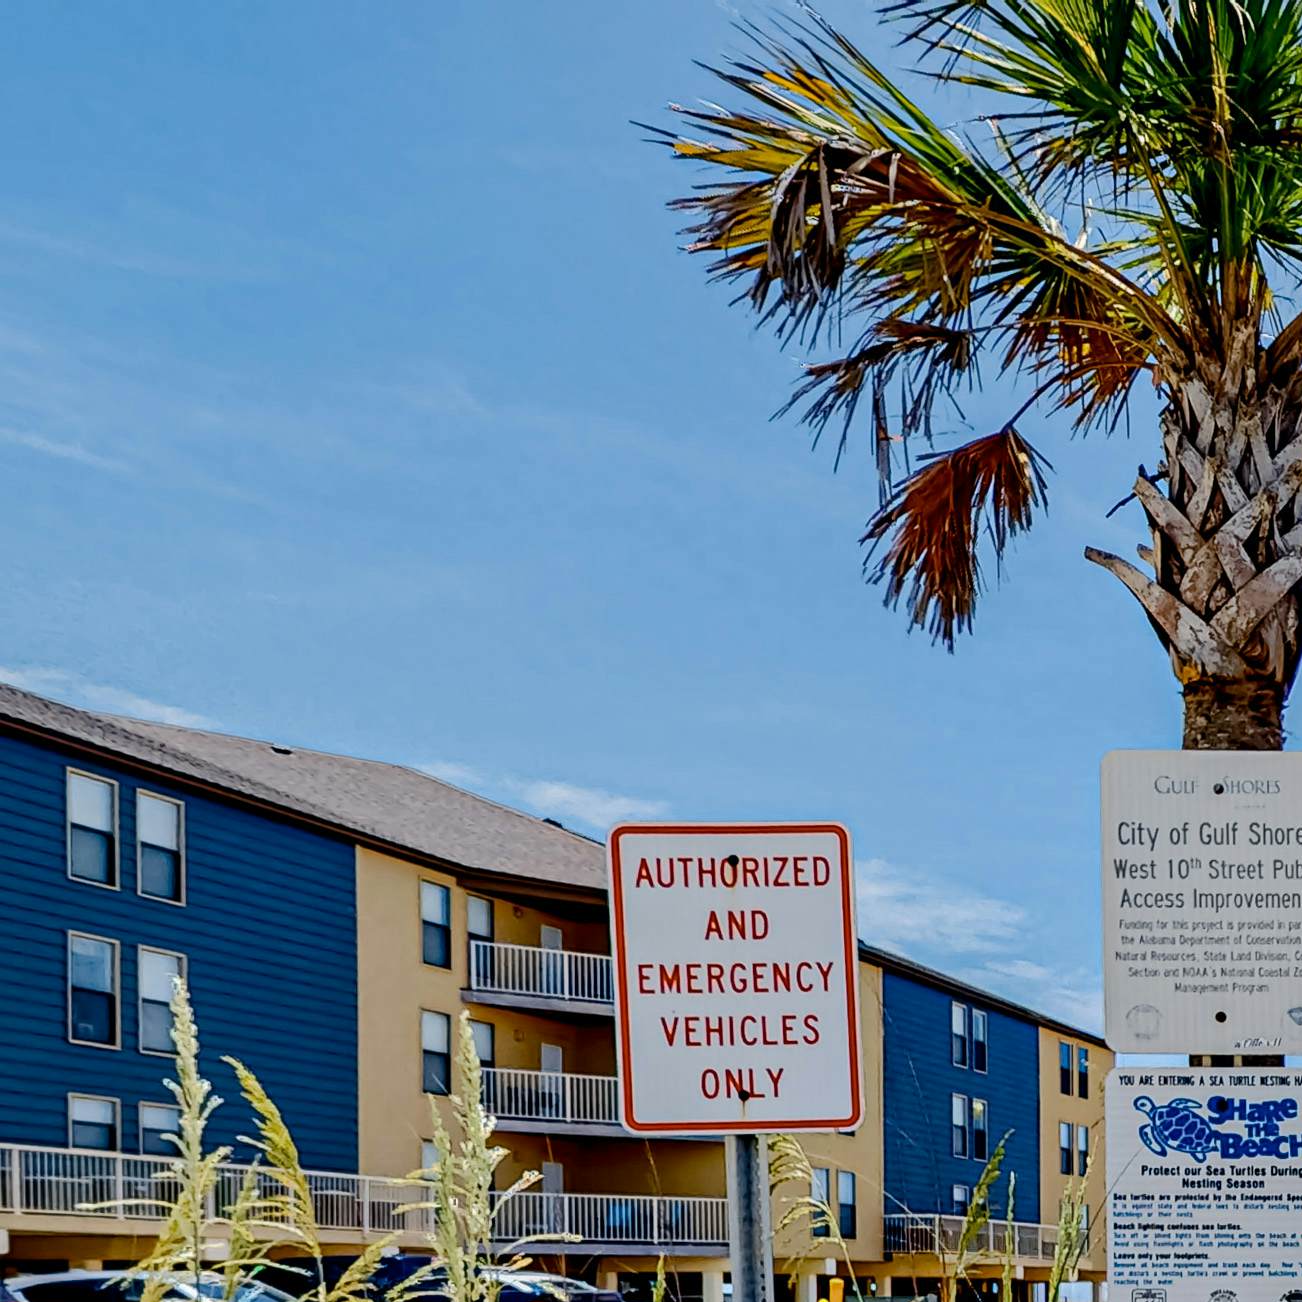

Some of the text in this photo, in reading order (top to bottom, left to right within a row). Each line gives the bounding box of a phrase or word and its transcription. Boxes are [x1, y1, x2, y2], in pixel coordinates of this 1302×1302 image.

[1117, 821, 1159, 851] City
[1169, 822, 1189, 845] of
[1199, 822, 1238, 845] Gulf
[635, 856, 831, 888] AUTHORIZED
[1114, 859, 1157, 880] West
[1168, 857, 1201, 879] 10th
[1208, 859, 1264, 880] Street
[1120, 888, 1185, 908] Access
[704, 910, 769, 940] AND
[1119, 919, 1152, 931] Funding
[1156, 920, 1168, 930] for
[1173, 920, 1188, 930] this
[1192, 920, 1223, 932] project
[1227, 920, 1234, 930] is
[1238, 920, 1274, 931] provided
[1278, 920, 1285, 930] in
[1121, 935, 1134, 944] the
[1139, 935, 1175, 944] Alabama
[1180, 935, 1230, 947] Department
[1233, 935, 1242, 944] of
[1247, 935, 1301, 944] Conservation
[1115, 951, 1147, 961] Natural
[1204, 951, 1226, 961] State
[1231, 951, 1251, 961] Land
[638, 962, 834, 994] EMERGENCY
[1128, 967, 1160, 977] Section
[1164, 967, 1179, 977] and
[1221, 967, 1254, 977] National
[1259, 967, 1290, 977] Coastal
[1174, 982, 1269, 995] Management Program
[660, 1015, 820, 1047] VEHICLES
[701, 1068, 784, 1099] ONLY
[1119, 1075, 1134, 1086] YOU
[1139, 1075, 1154, 1086] ARE
[1158, 1075, 1194, 1086] ENTERING
[1200, 1075, 1205, 1086] A
[1209, 1075, 1224, 1086] SEA
[1229, 1075, 1255, 1086] TURTLE
[1260, 1075, 1291, 1086] NESTING
[1141, 1166, 1180, 1176] Protect
[1184, 1168, 1201, 1176] our
[1206, 1166, 1225, 1176] Sea
[1230, 1166, 1265, 1176] Turtles
[1182, 1178, 1264, 1190] Nesting Season
[1113, 1193, 1126, 1201] Sea
[1159, 1193, 1170, 1201] are
[1175, 1193, 1209, 1202] protected
[1213, 1193, 1222, 1202] by
[1225, 1193, 1236, 1201] the
[1240, 1193, 1283, 1202] Endangered
[1113, 1222, 1135, 1230] Beach
[1138, 1222, 1164, 1231] lighting
[1167, 1222, 1199, 1230] confuses
[1202, 1222, 1214, 1230] sea
